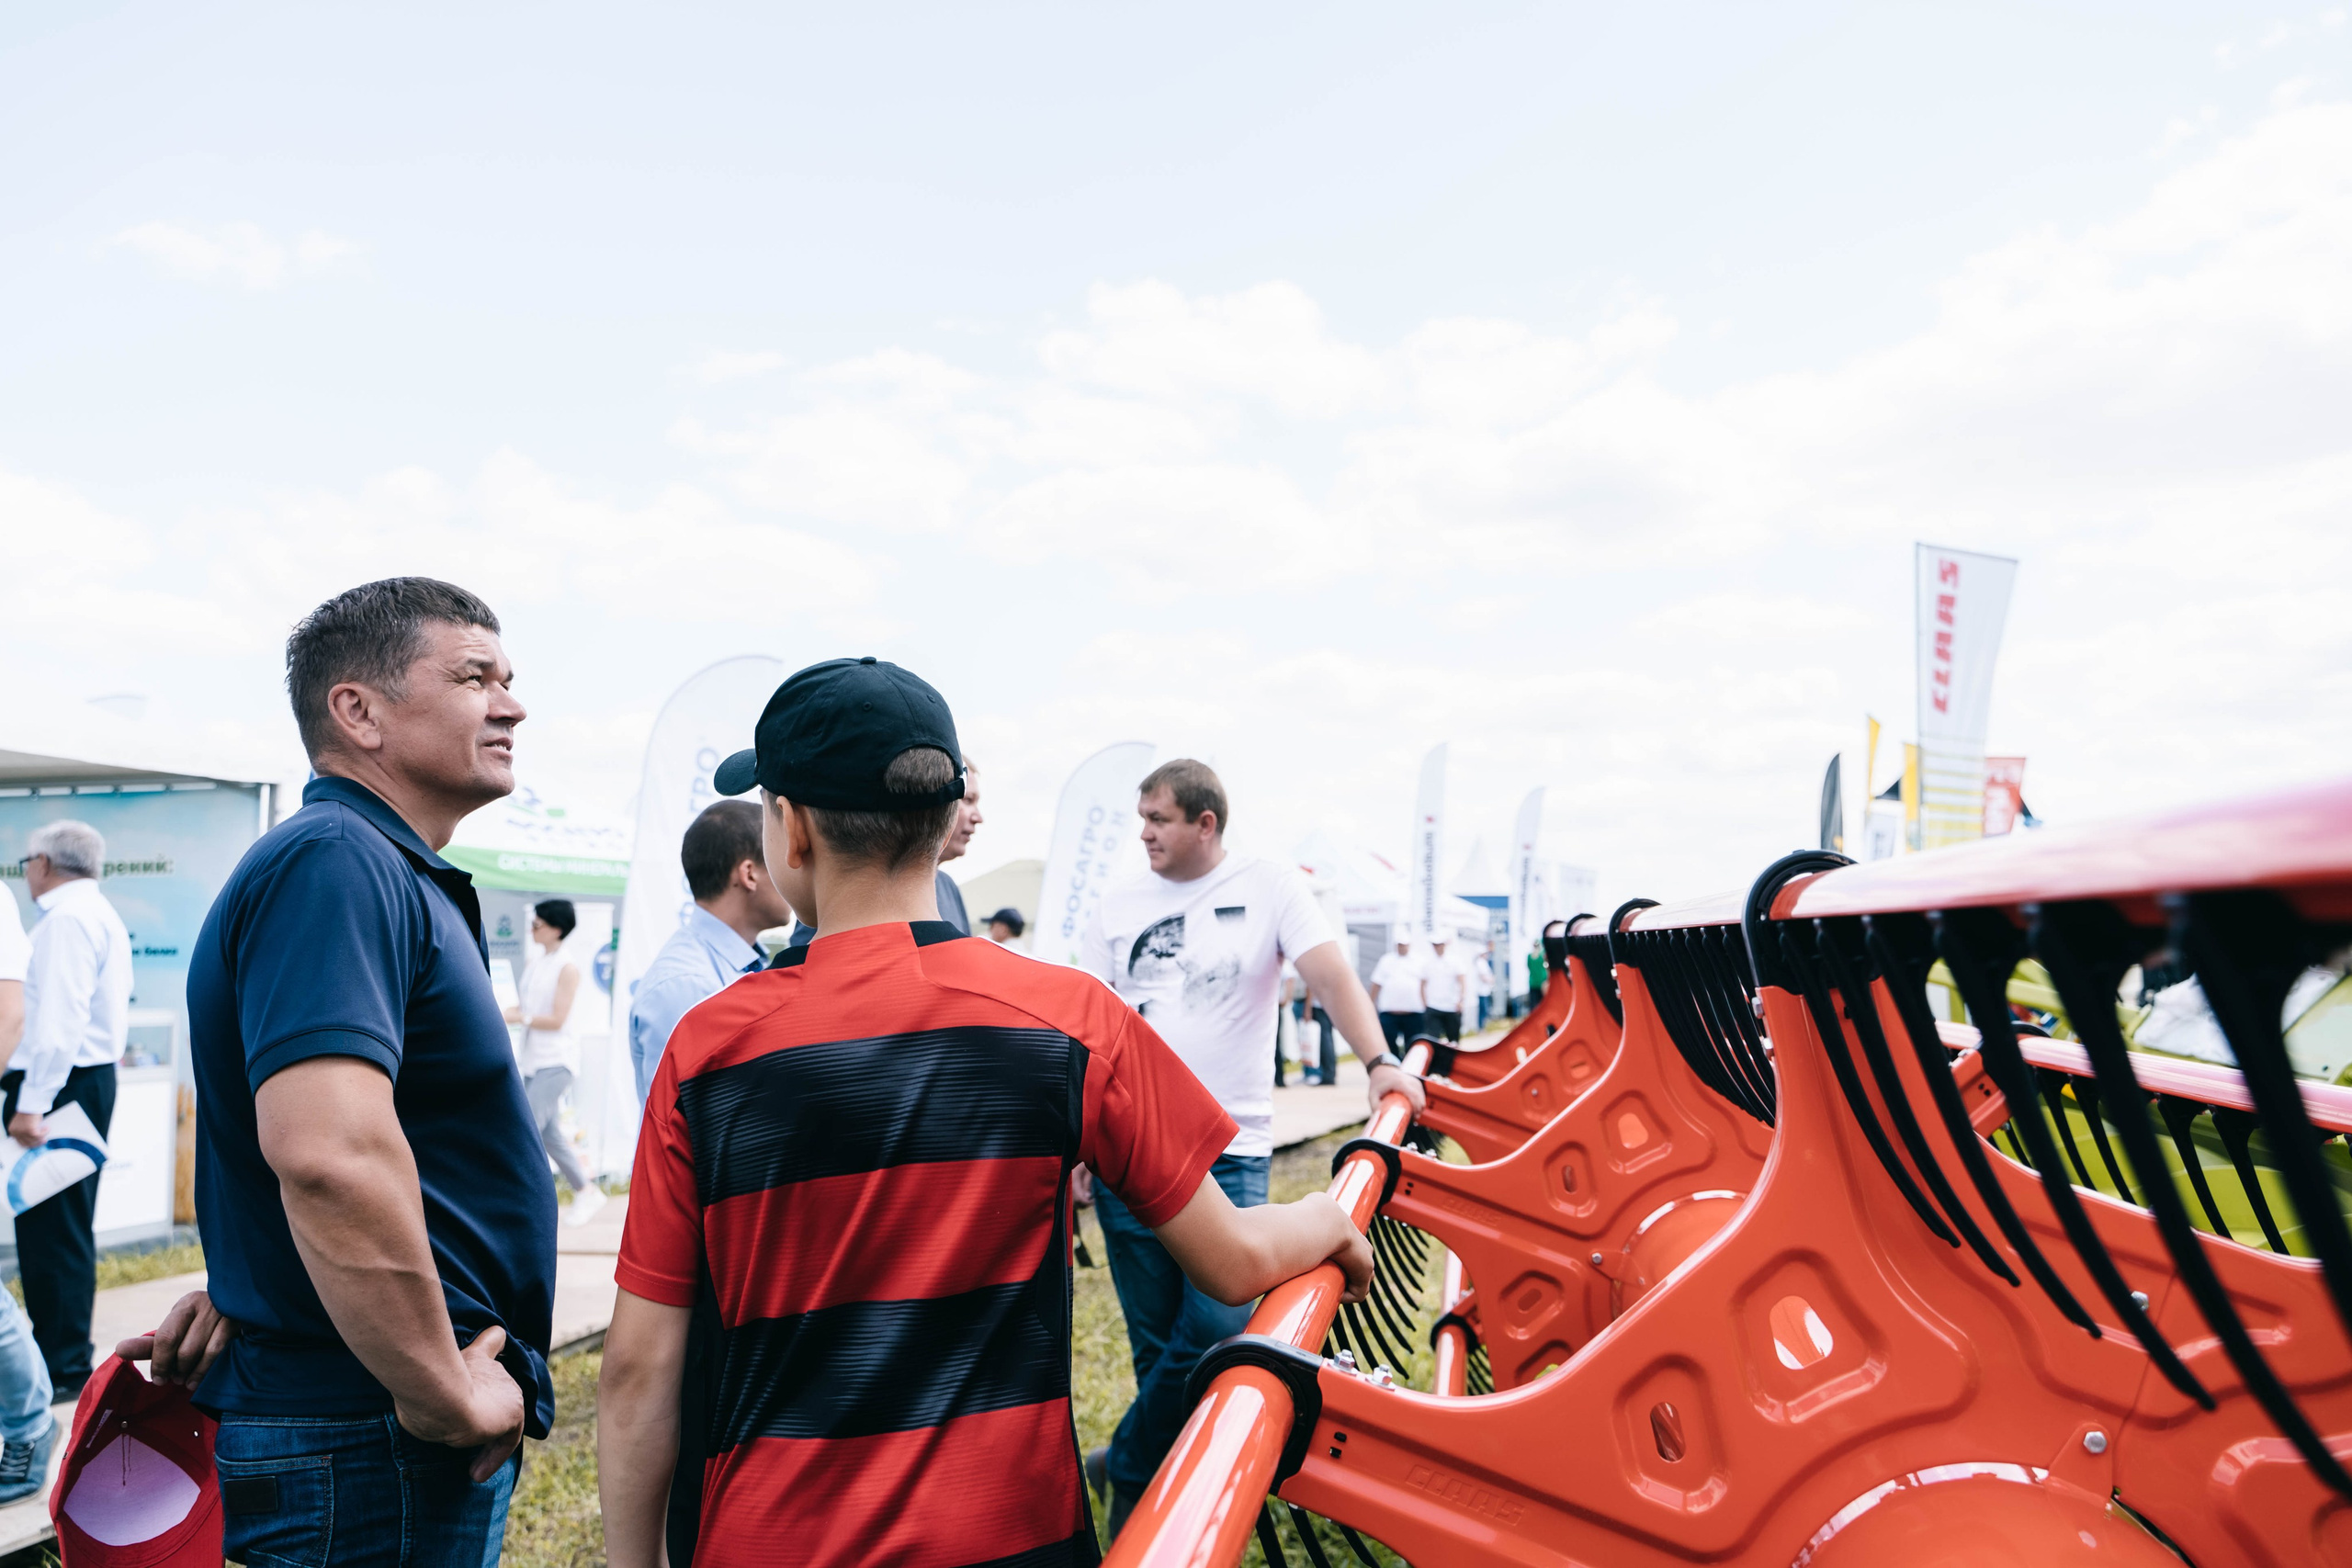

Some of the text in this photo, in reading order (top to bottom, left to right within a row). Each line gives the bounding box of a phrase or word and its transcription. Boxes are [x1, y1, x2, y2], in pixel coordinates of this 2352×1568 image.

[1932, 559, 1959, 714] CLAAS
[102, 855, 175, 877] рений:
[1062, 806, 1105, 938] ФОСАГРО
[1405, 1463, 1526, 1527] CLAAS
